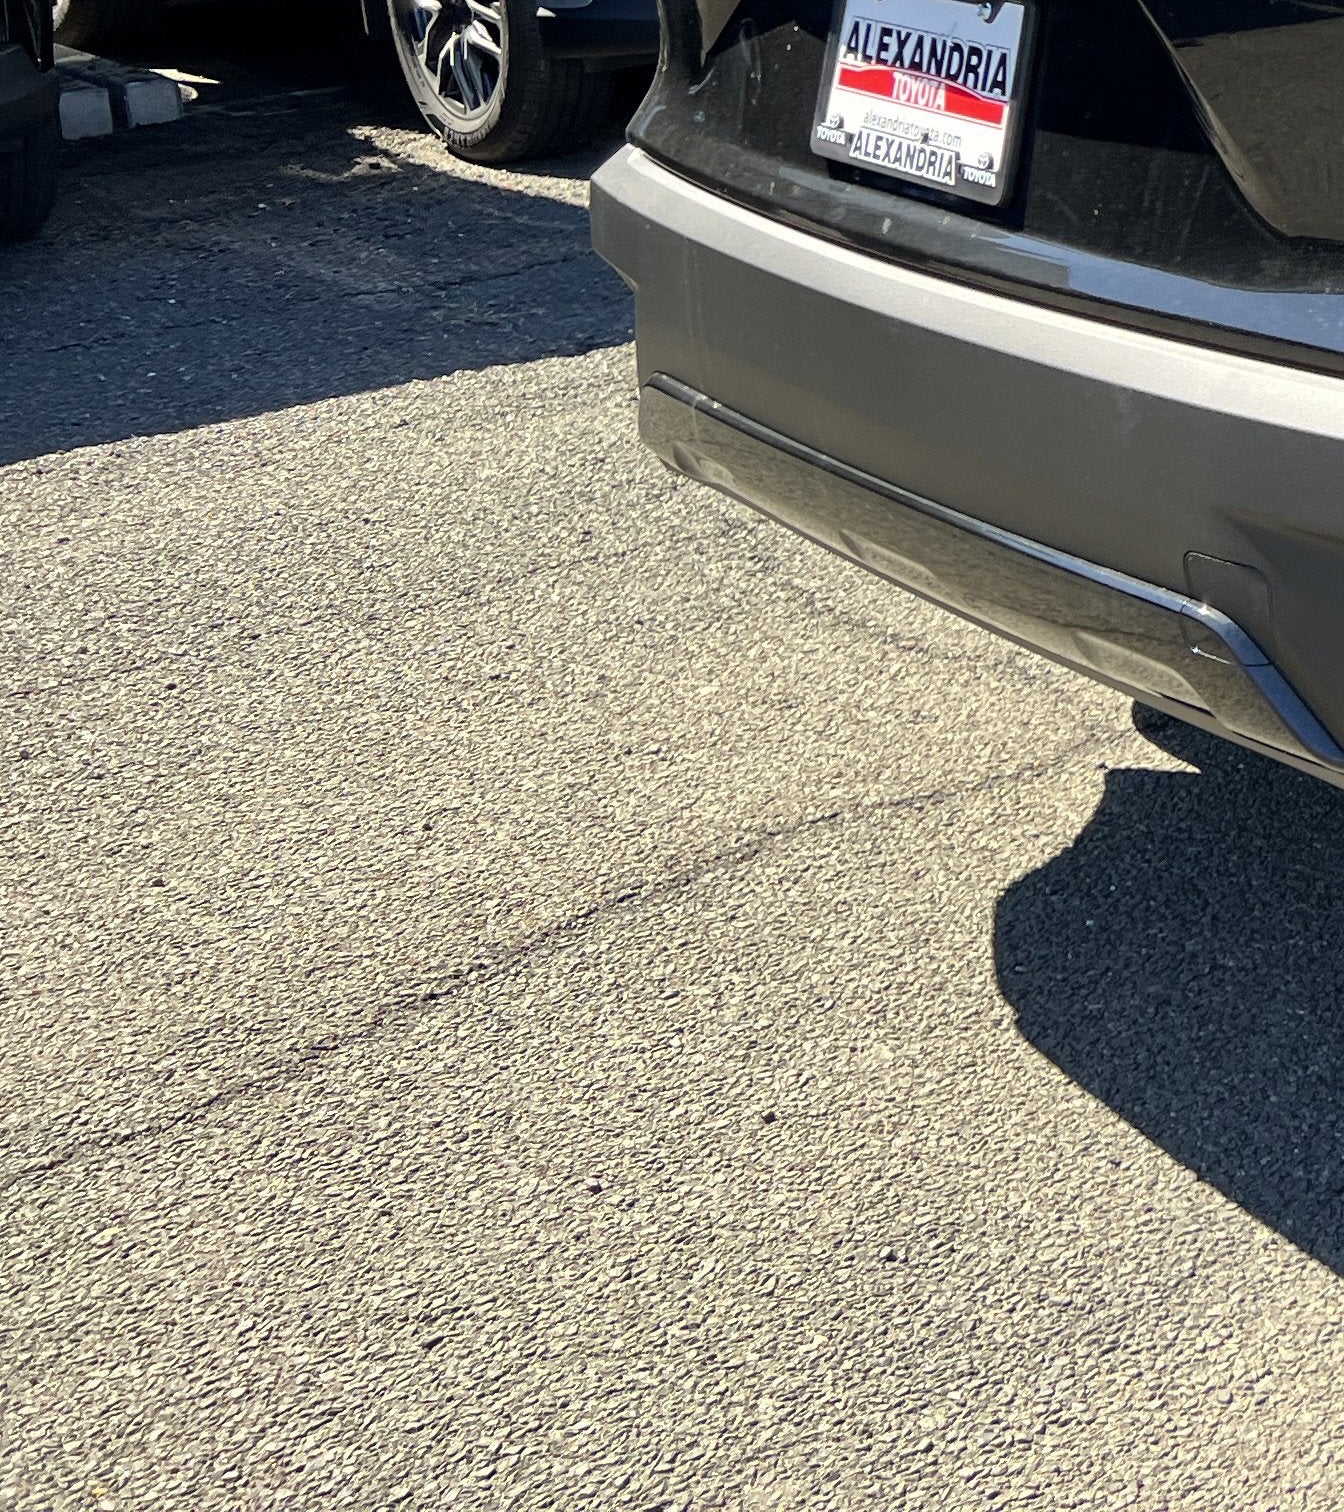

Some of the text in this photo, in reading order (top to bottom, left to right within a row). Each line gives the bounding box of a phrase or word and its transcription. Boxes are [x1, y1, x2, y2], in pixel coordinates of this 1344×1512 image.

[846, 19, 1008, 97] ALEXANDRIA
[892, 72, 947, 111] TOYOTA
[816, 126, 846, 146] TOYOTA
[853, 130, 954, 181] ALEXANDRIA
[963, 165, 996, 187] TOYOTA
